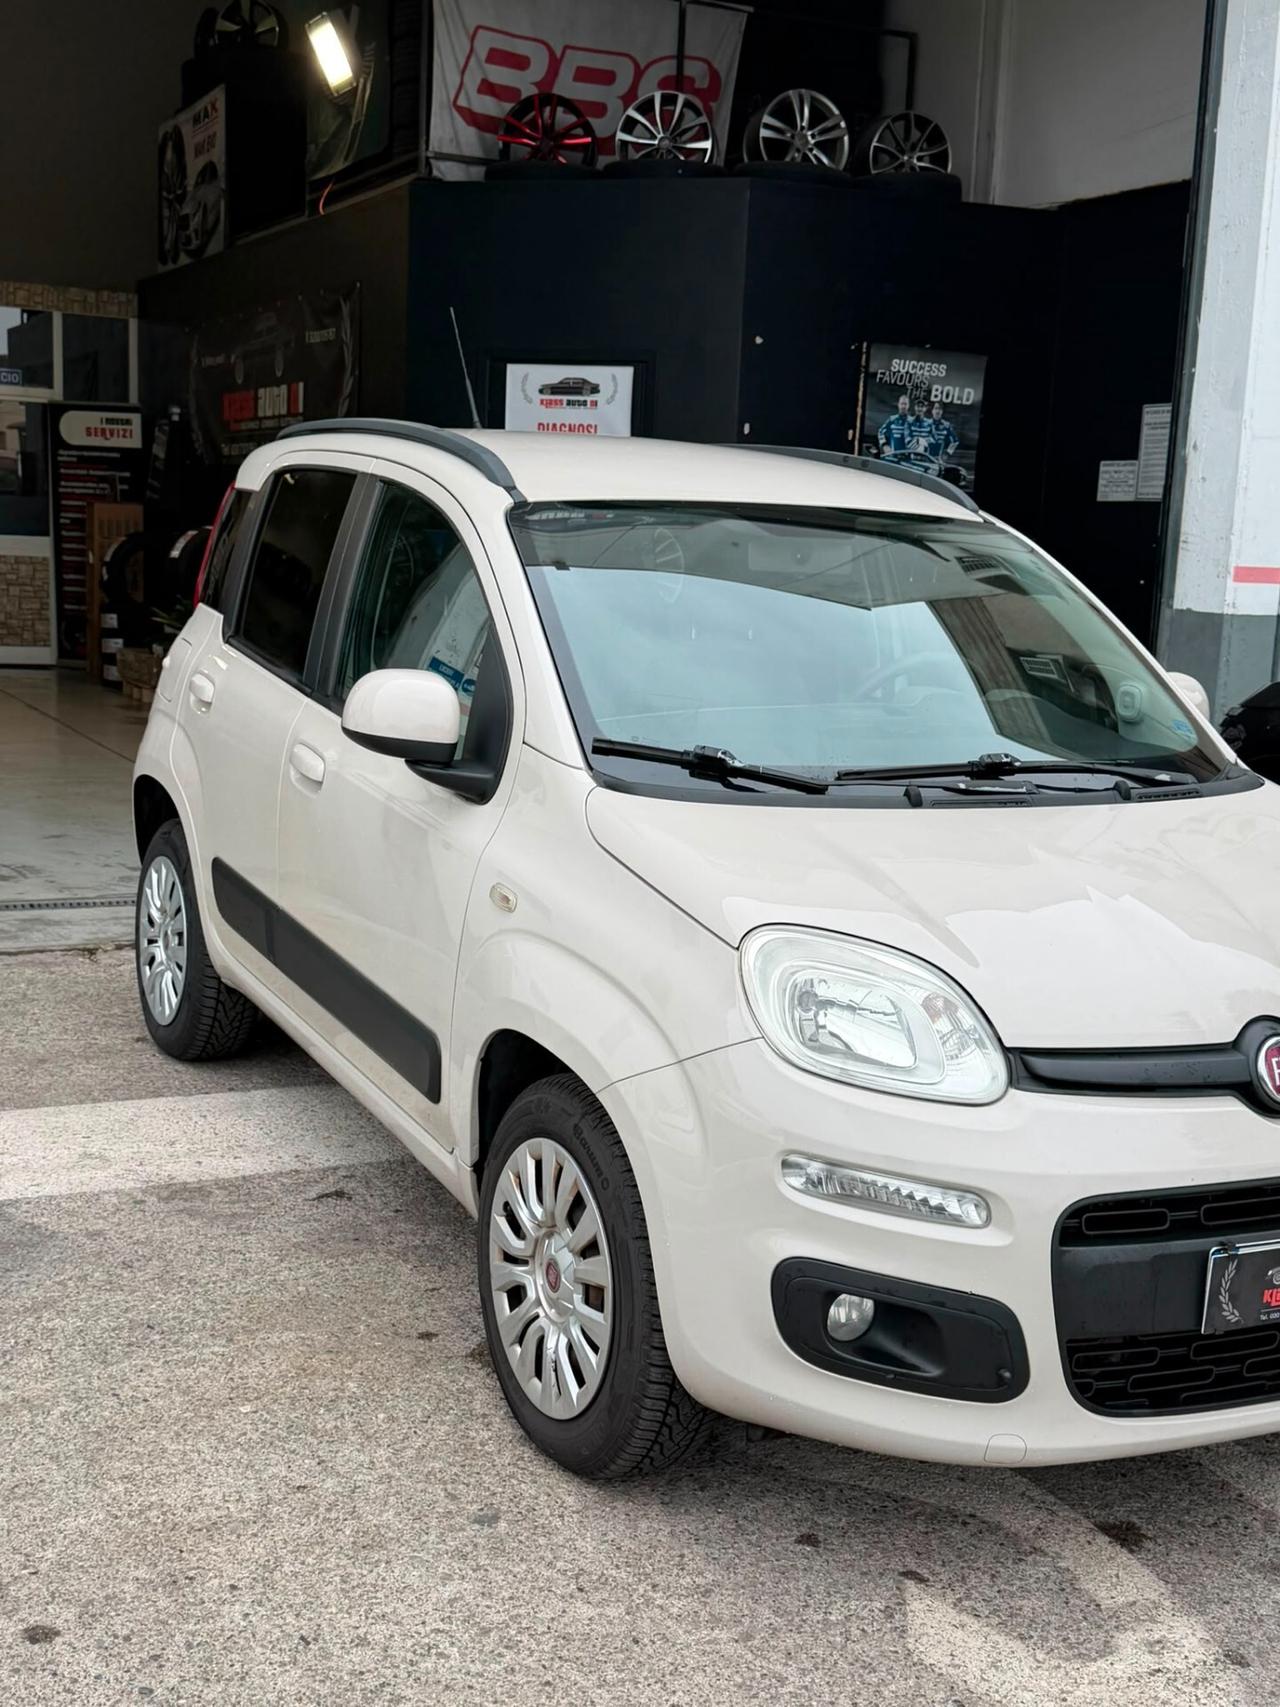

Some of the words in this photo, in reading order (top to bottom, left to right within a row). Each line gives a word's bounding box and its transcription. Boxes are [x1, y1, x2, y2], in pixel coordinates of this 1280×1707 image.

[891, 359, 947, 377] SUCCESS
[876, 369, 930, 388] FAVOURS
[930, 385, 974, 405] BOLD
[85, 427, 133, 440] SERVIZI
